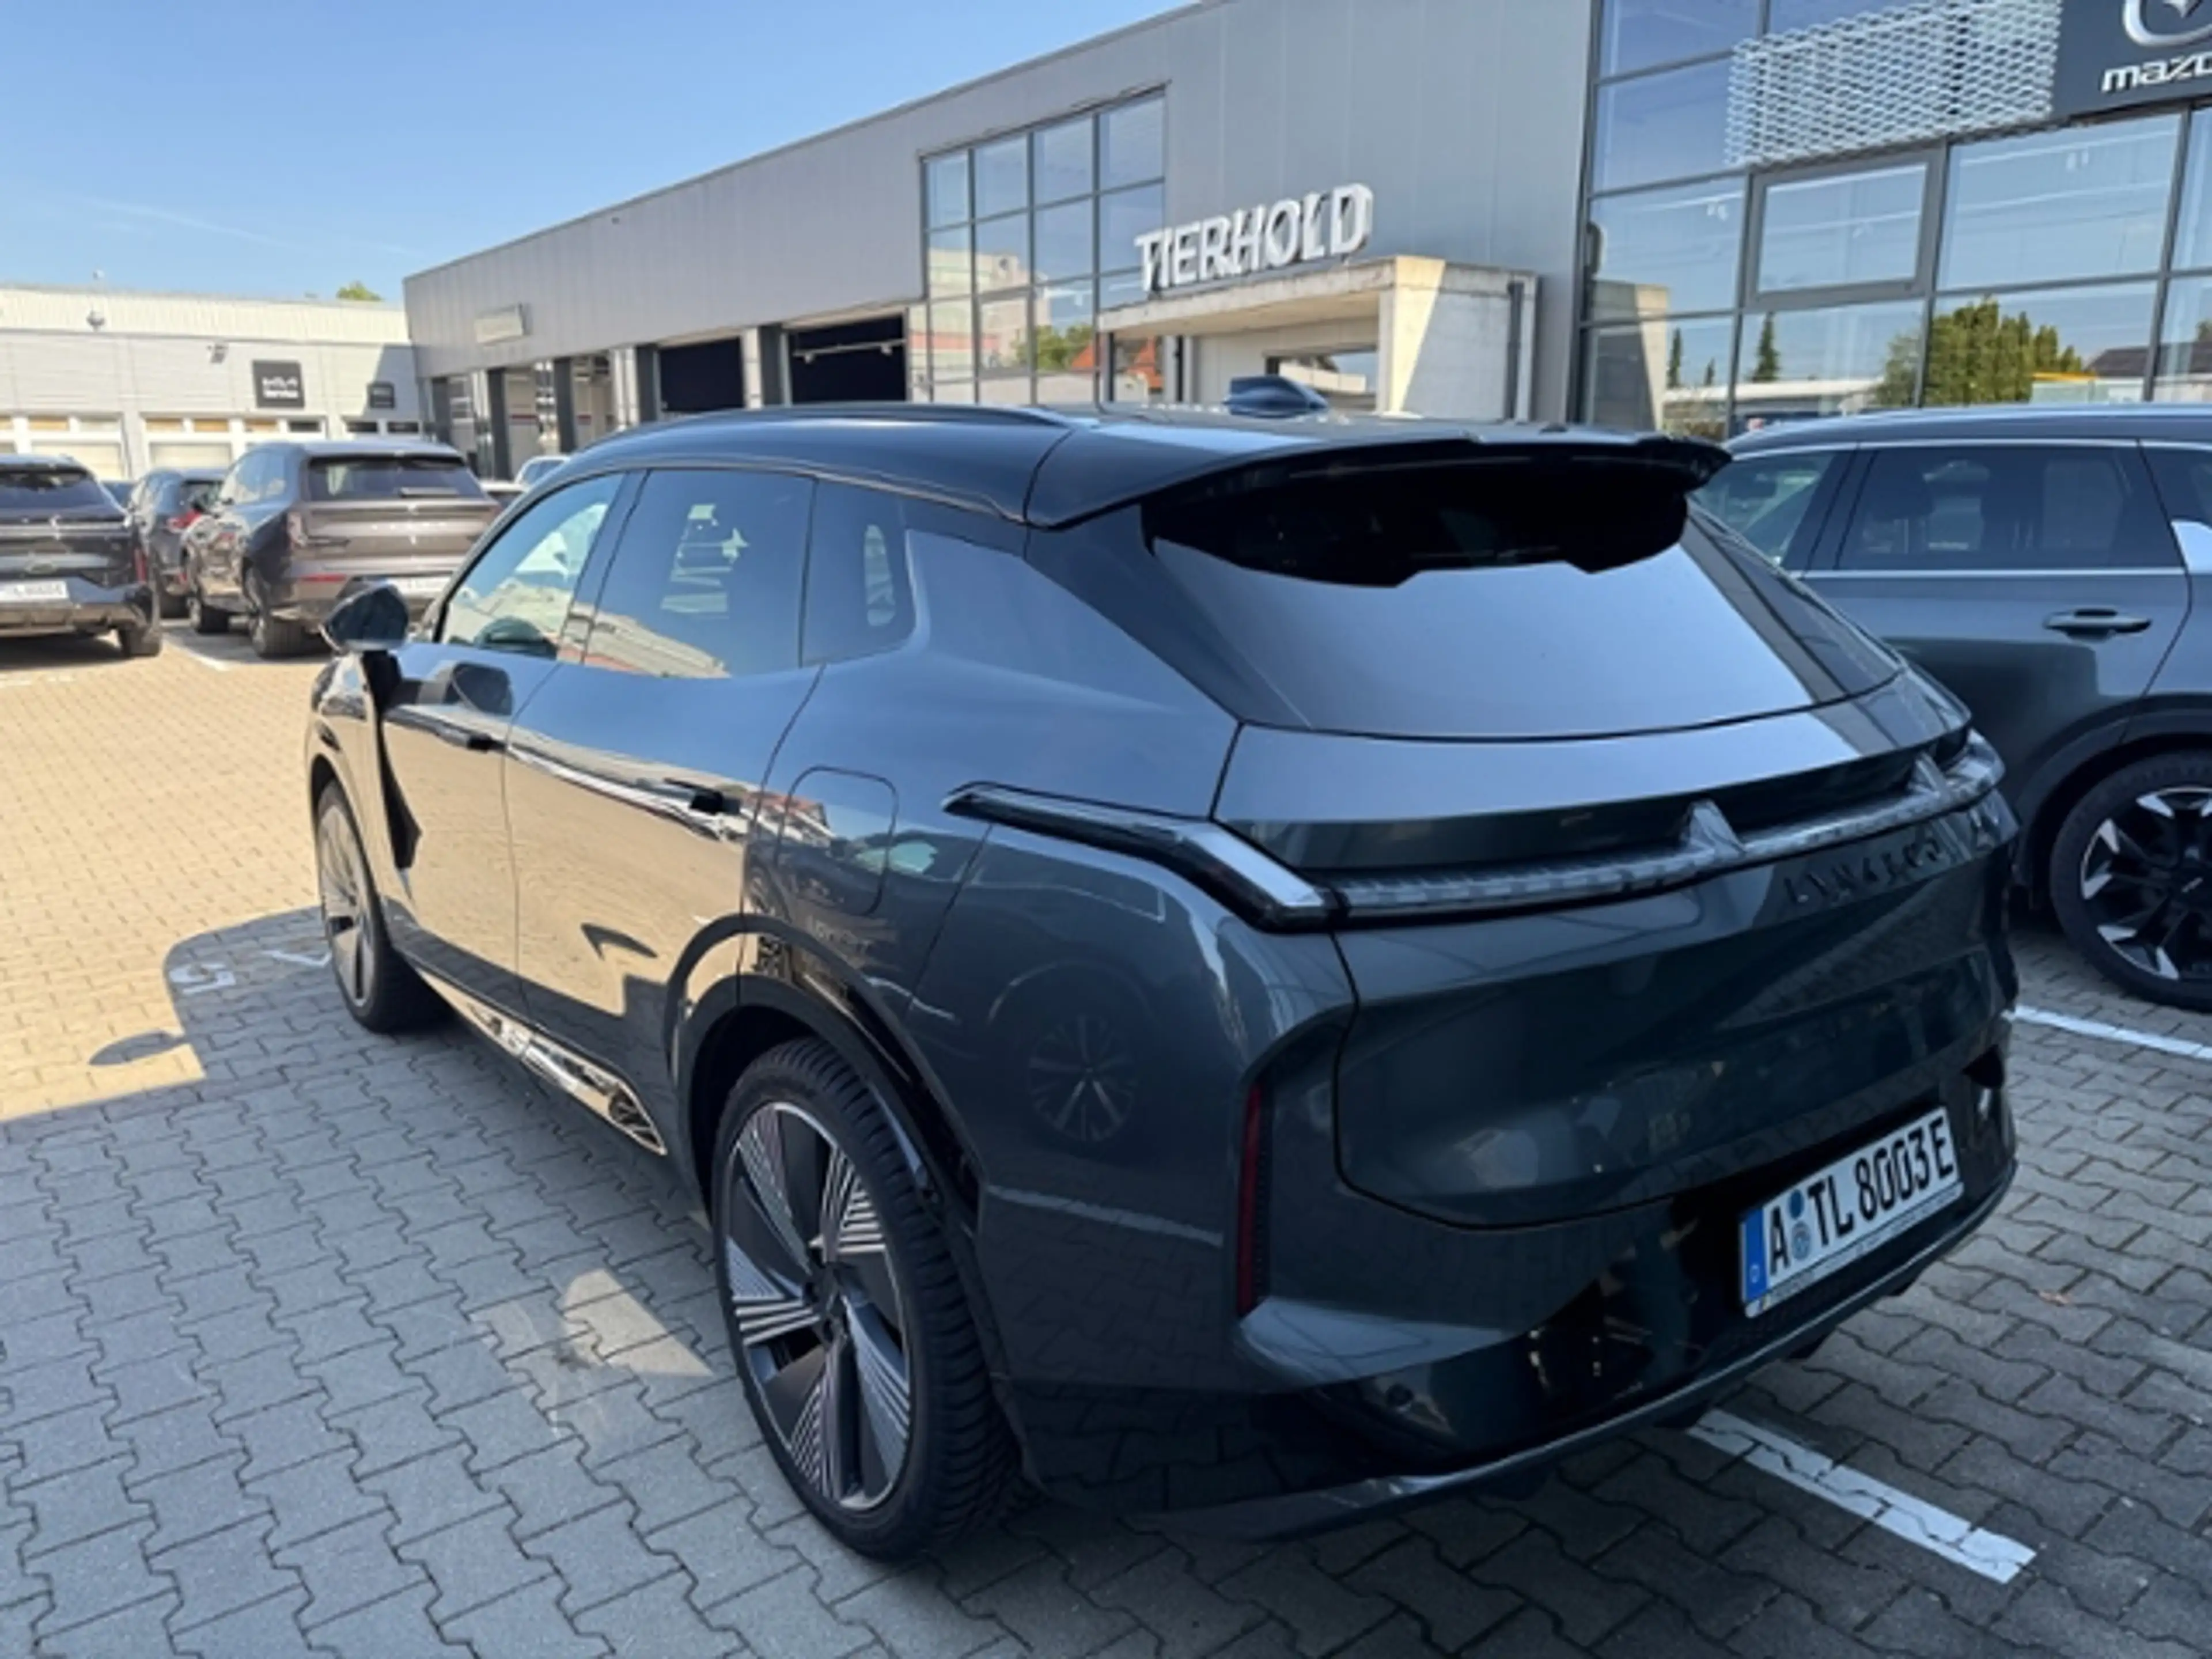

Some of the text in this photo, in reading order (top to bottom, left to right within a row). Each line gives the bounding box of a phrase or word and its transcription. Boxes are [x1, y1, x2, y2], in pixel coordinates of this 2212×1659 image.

[1133, 183, 1374, 292] TIERHOLD
[1768, 1205, 1790, 1276] A
[1806, 1175, 1854, 1247] TL
[1855, 1115, 1954, 1221] 8003E
